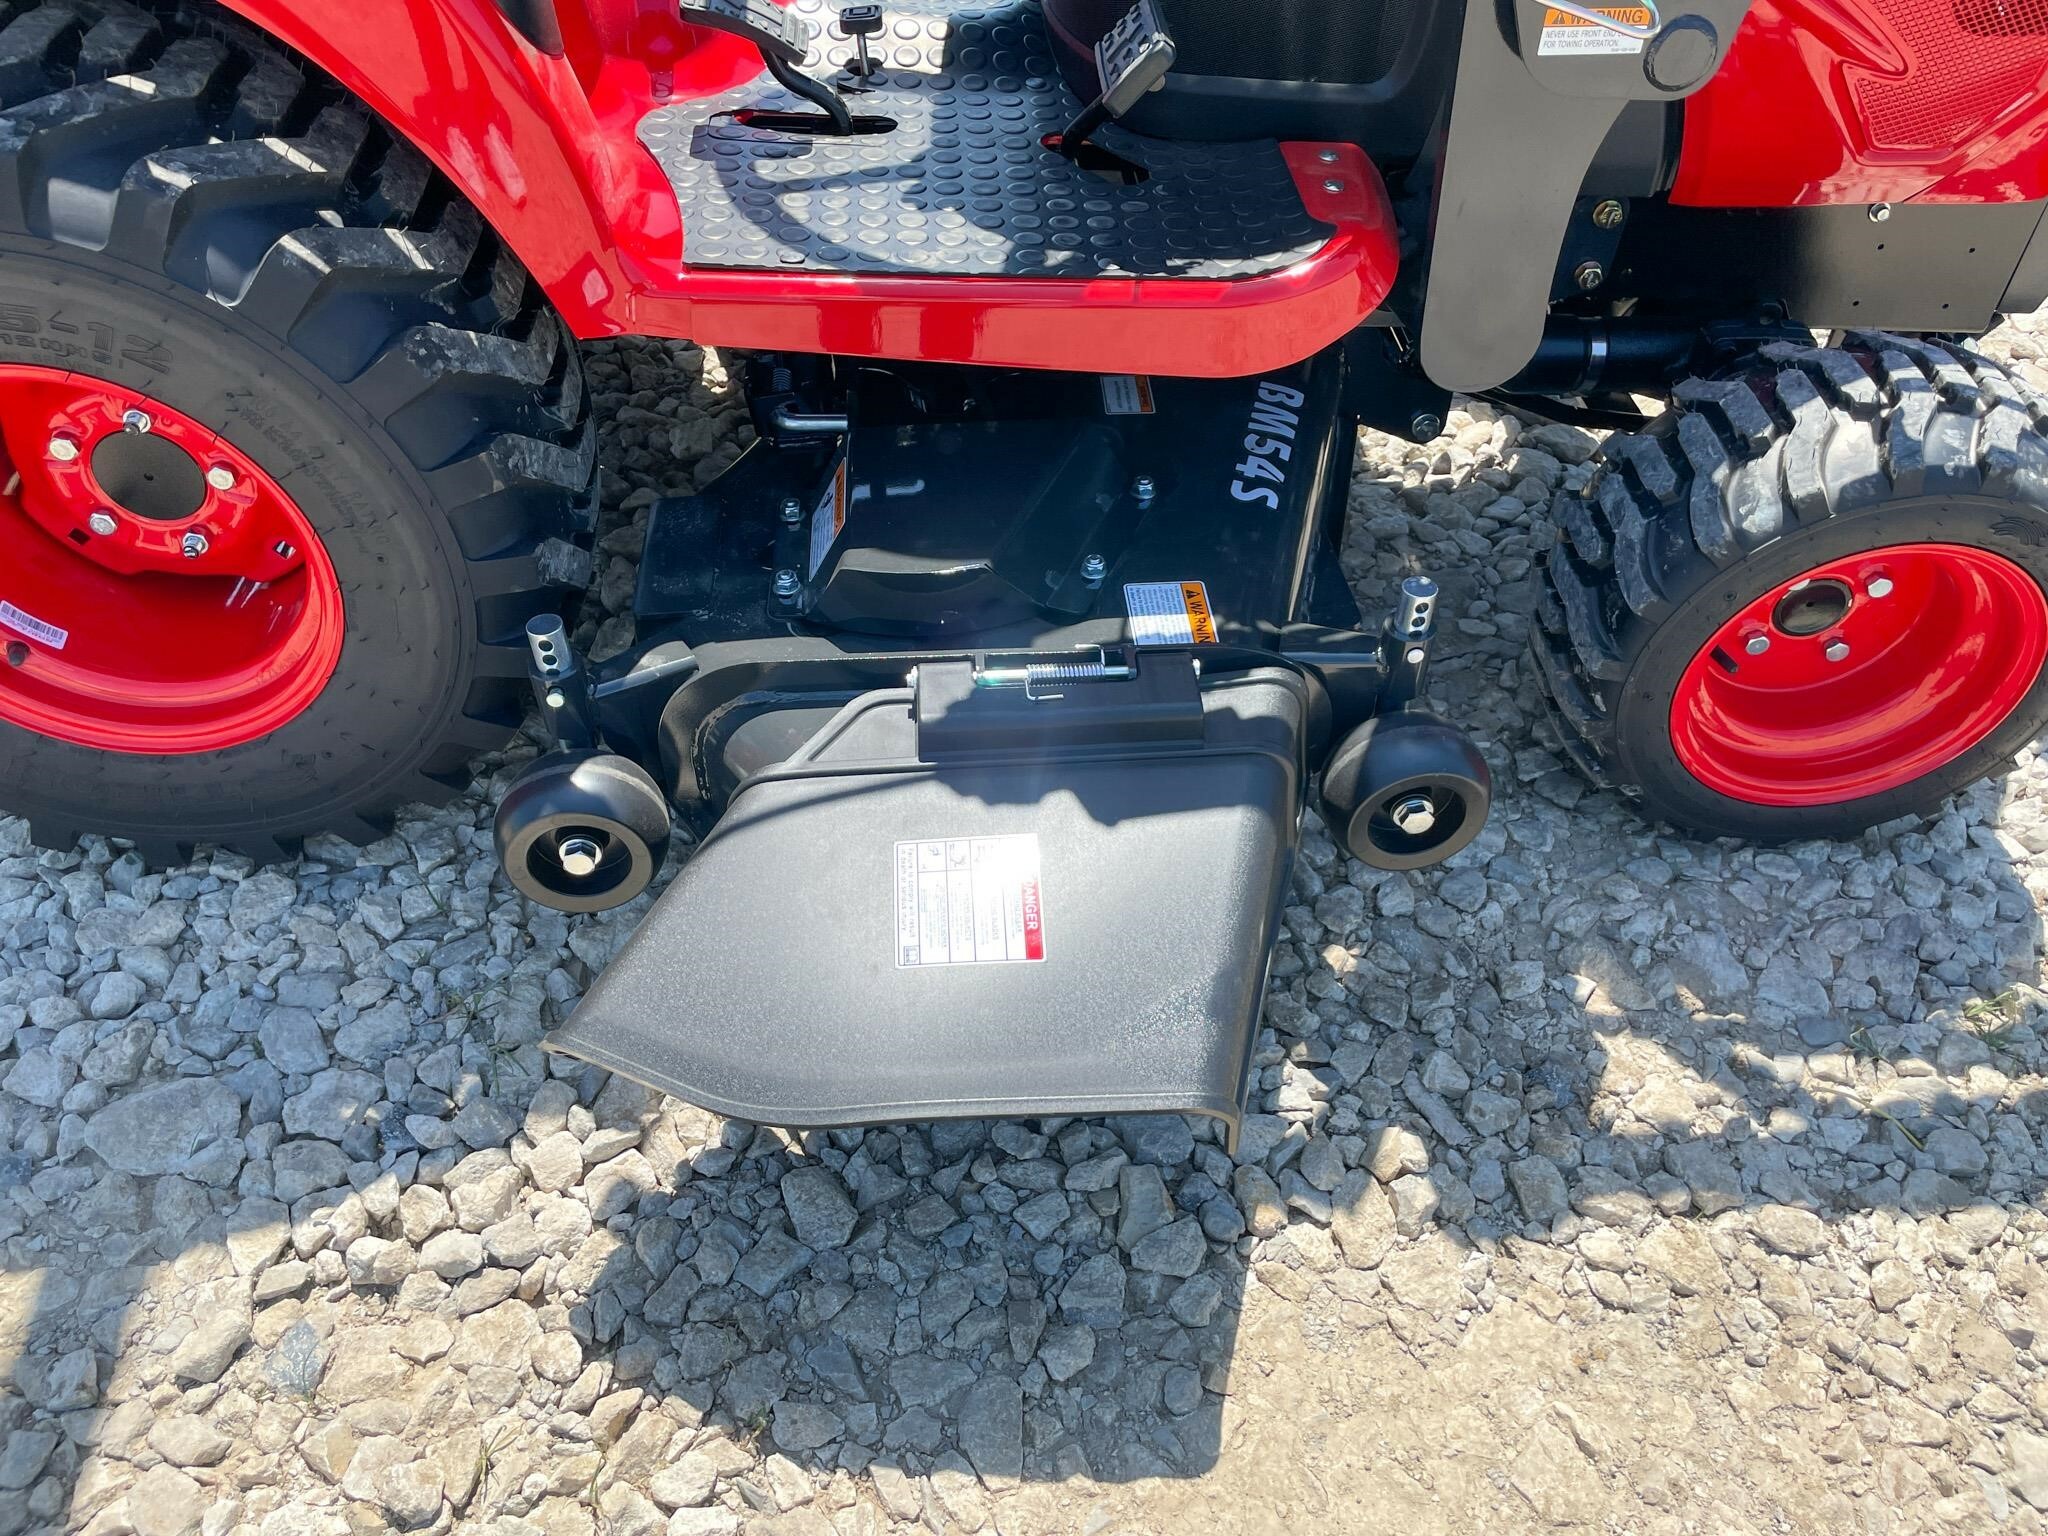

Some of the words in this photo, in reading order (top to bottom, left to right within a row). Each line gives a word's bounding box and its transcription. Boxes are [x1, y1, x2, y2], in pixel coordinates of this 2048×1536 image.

[1570, 9, 1643, 24] WNING
[1545, 30, 1565, 38] NEVER
[1567, 30, 1579, 38] USE
[1581, 30, 1601, 38] FRONT
[1543, 40, 1556, 48] FOR
[1558, 40, 1583, 48] TOWING
[1230, 381, 1305, 510] BM54S
[1024, 881, 1039, 931] DANGER
